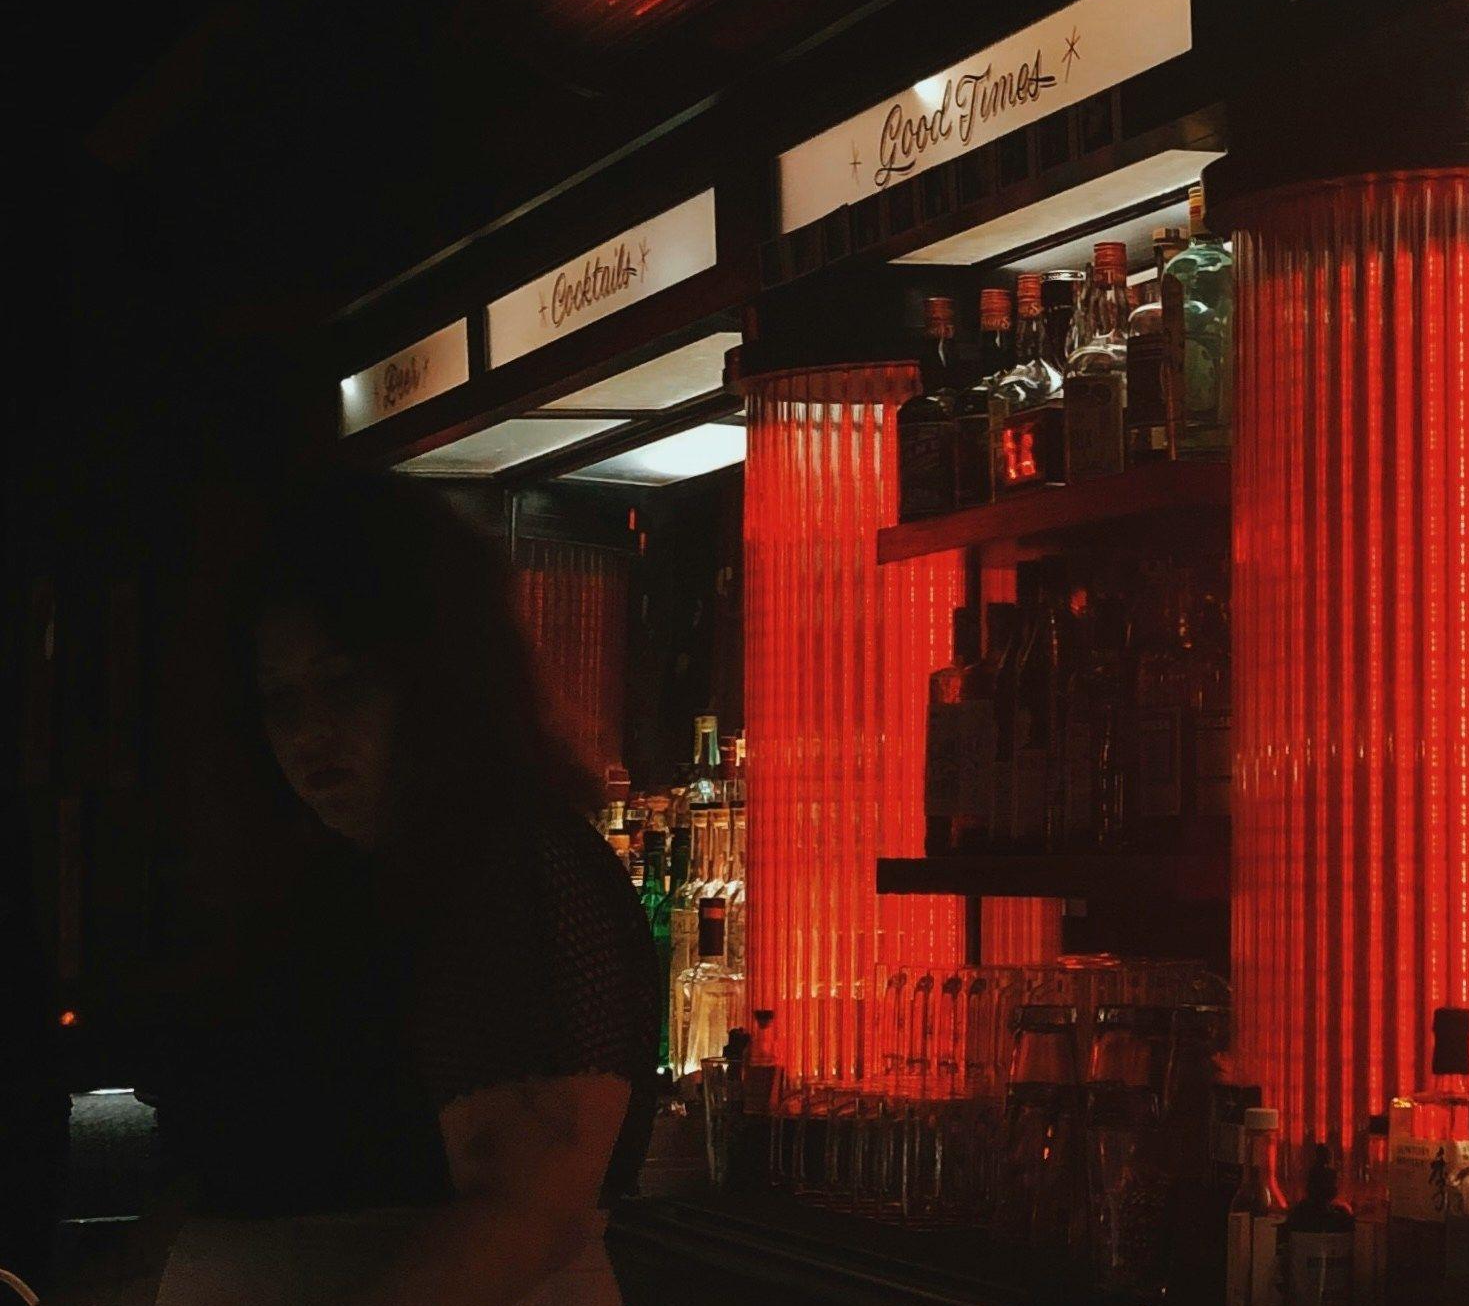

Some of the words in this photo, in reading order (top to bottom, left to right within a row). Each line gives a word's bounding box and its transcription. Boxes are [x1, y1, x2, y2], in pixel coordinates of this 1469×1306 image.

[874, 79, 956, 187] Good
[955, 49, 1058, 147] Times
[551, 243, 638, 329] Cocktails
